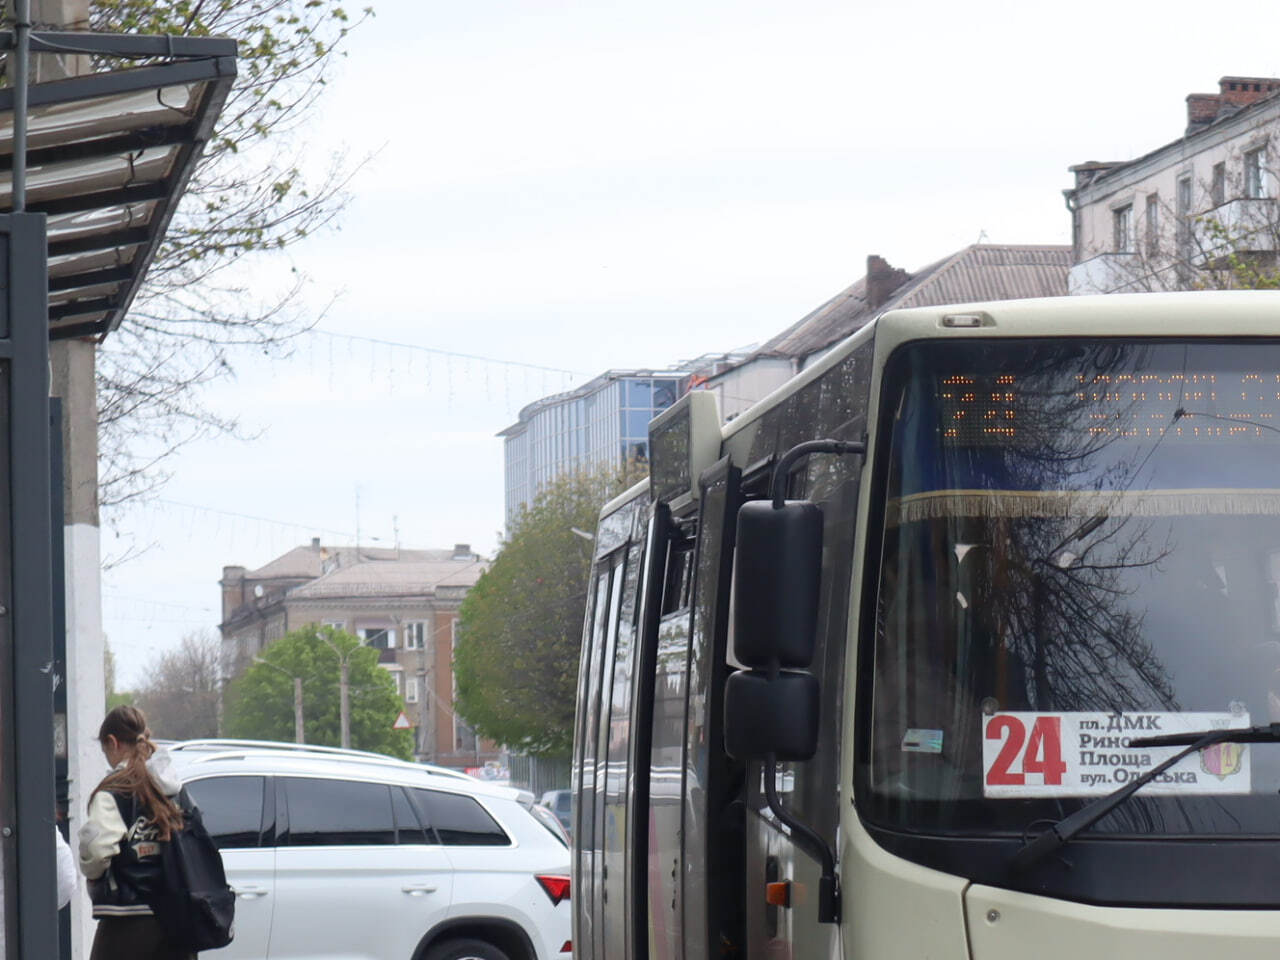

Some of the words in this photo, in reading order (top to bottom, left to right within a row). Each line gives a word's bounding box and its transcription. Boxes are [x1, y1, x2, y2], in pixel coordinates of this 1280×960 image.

[1079, 733, 1136, 748] Рино
[985, 715, 1066, 785] 24
[1079, 751, 1152, 768] Площа
